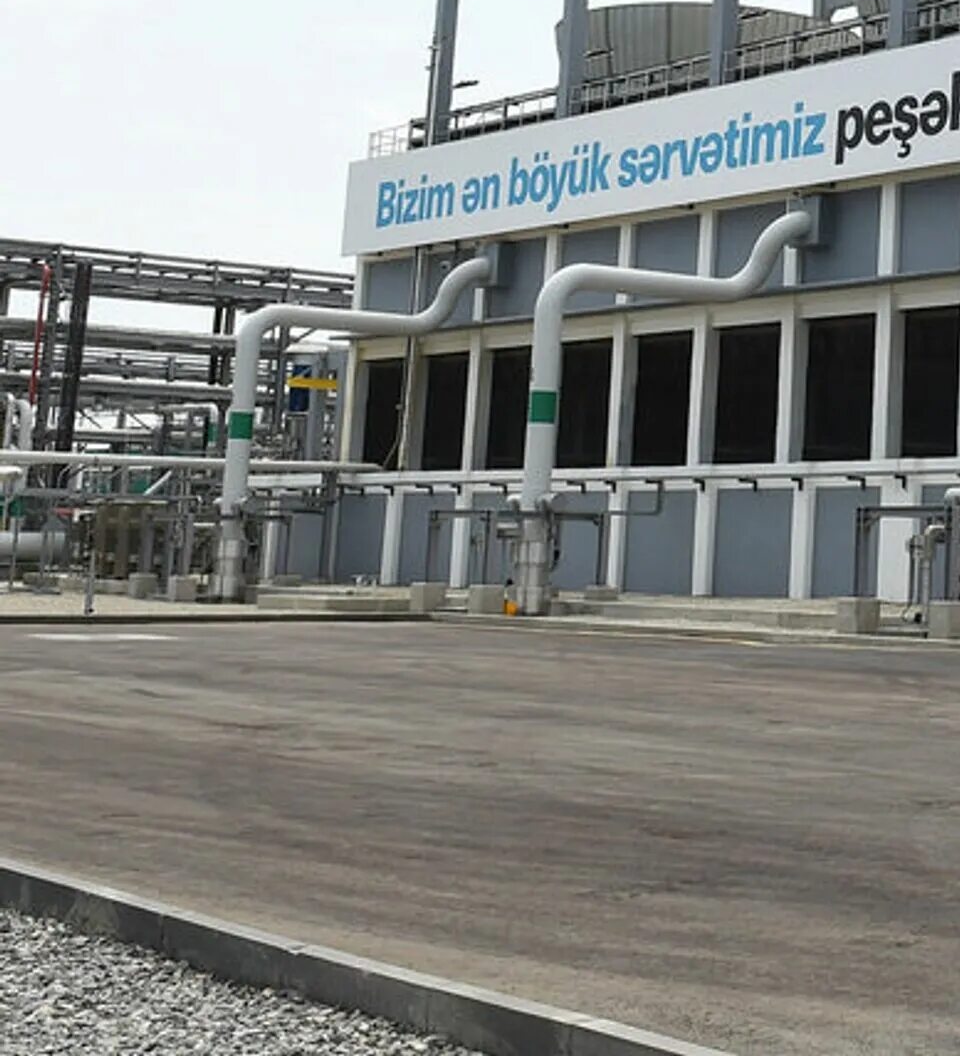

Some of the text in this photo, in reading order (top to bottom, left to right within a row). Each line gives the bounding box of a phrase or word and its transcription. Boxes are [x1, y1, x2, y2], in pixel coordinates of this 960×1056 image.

[376, 175, 456, 229] Bizim
[461, 174, 502, 214] ən
[507, 142, 611, 213] böyük
[617, 102, 827, 189] sərvətimiz
